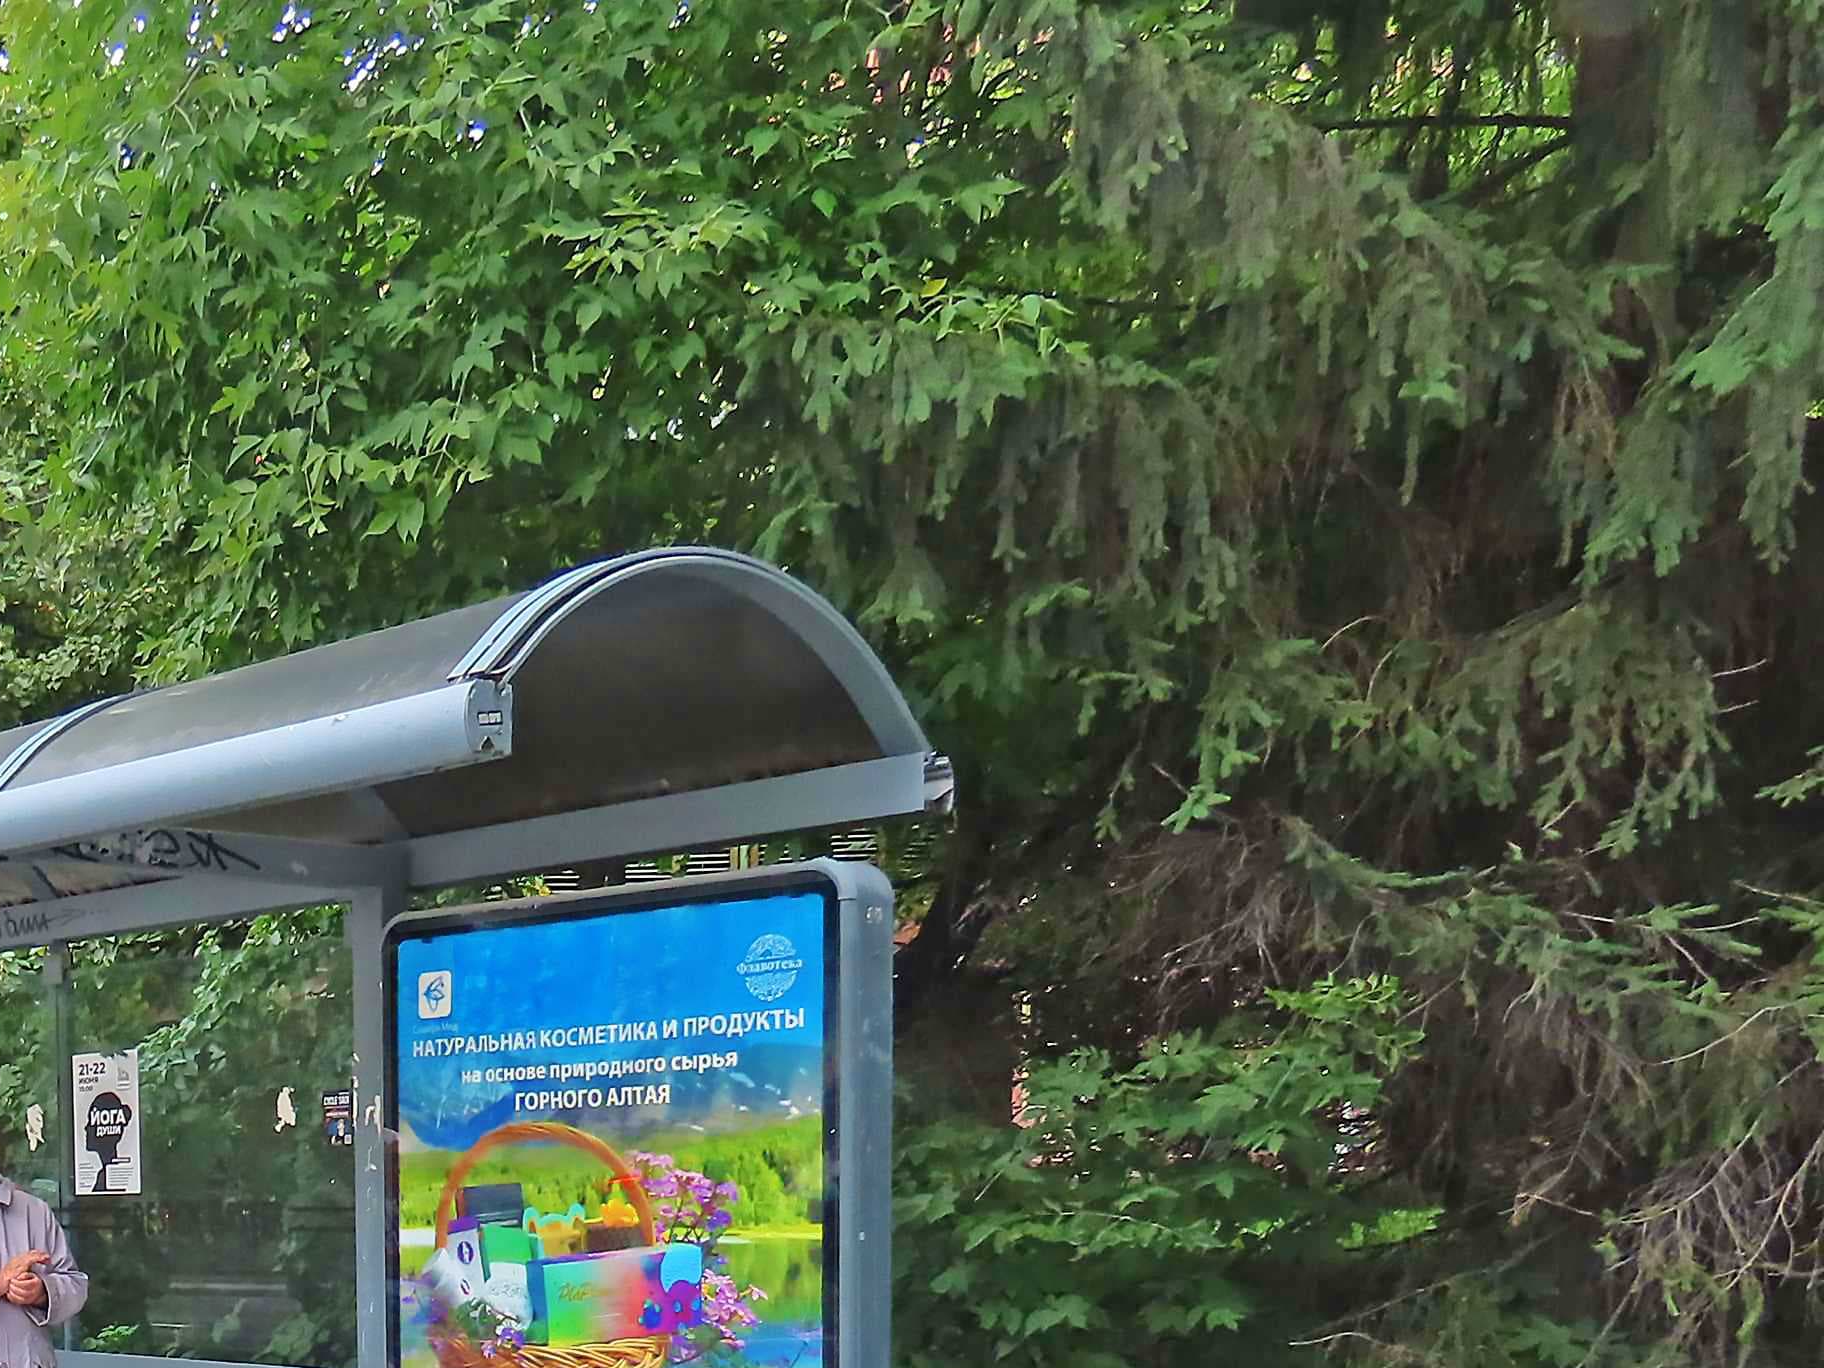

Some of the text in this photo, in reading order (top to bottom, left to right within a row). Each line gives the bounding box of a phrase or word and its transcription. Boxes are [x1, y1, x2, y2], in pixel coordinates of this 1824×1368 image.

[412, 1008, 805, 1058] НАТУРАЛЬНАЯ КОСМЕТИКА И ПРОДУКТЫ
[78, 1062, 106, 1076] 21-22
[461, 1051, 738, 1084] на основе природного сырья
[514, 1083, 671, 1112] ГОРНОГО АЛТАЯ
[90, 1106, 127, 1126] ЙОГА
